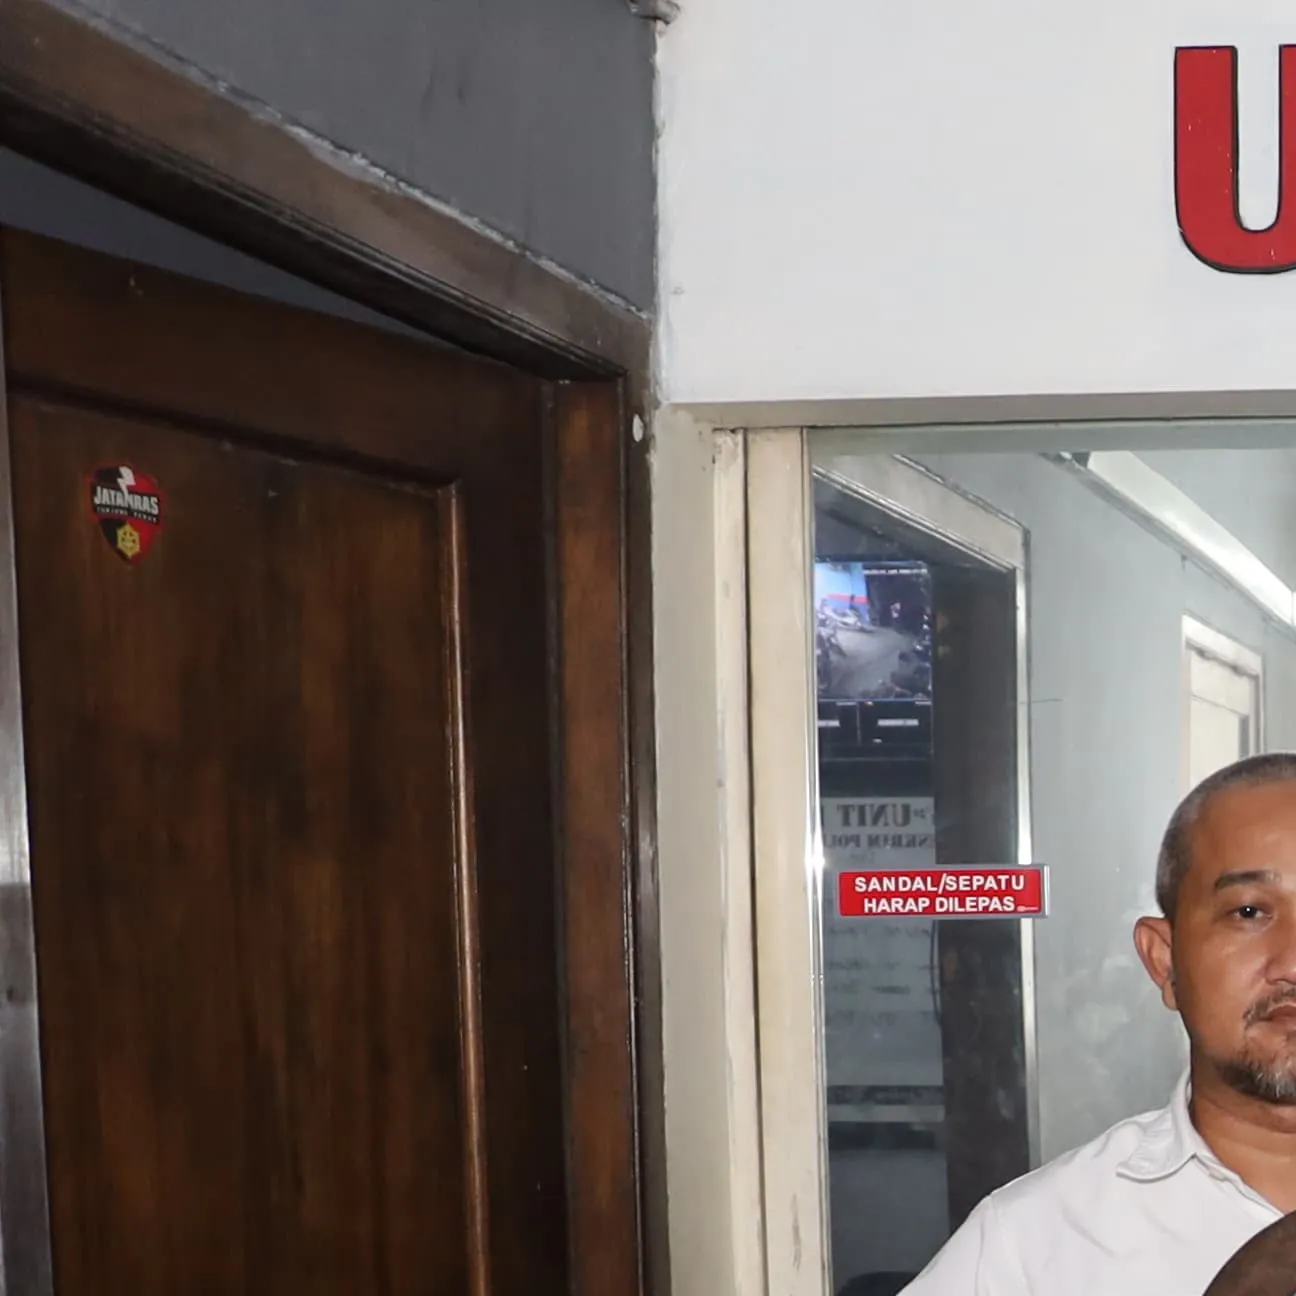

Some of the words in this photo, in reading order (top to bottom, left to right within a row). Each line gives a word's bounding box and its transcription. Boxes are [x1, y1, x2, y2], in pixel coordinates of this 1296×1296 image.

[93, 485, 159, 515] JATANRAS
[854, 873, 1025, 894] SANDAL/SEPATU
[863, 897, 930, 913] HARAP
[935, 896, 1015, 912] DILEPAS
